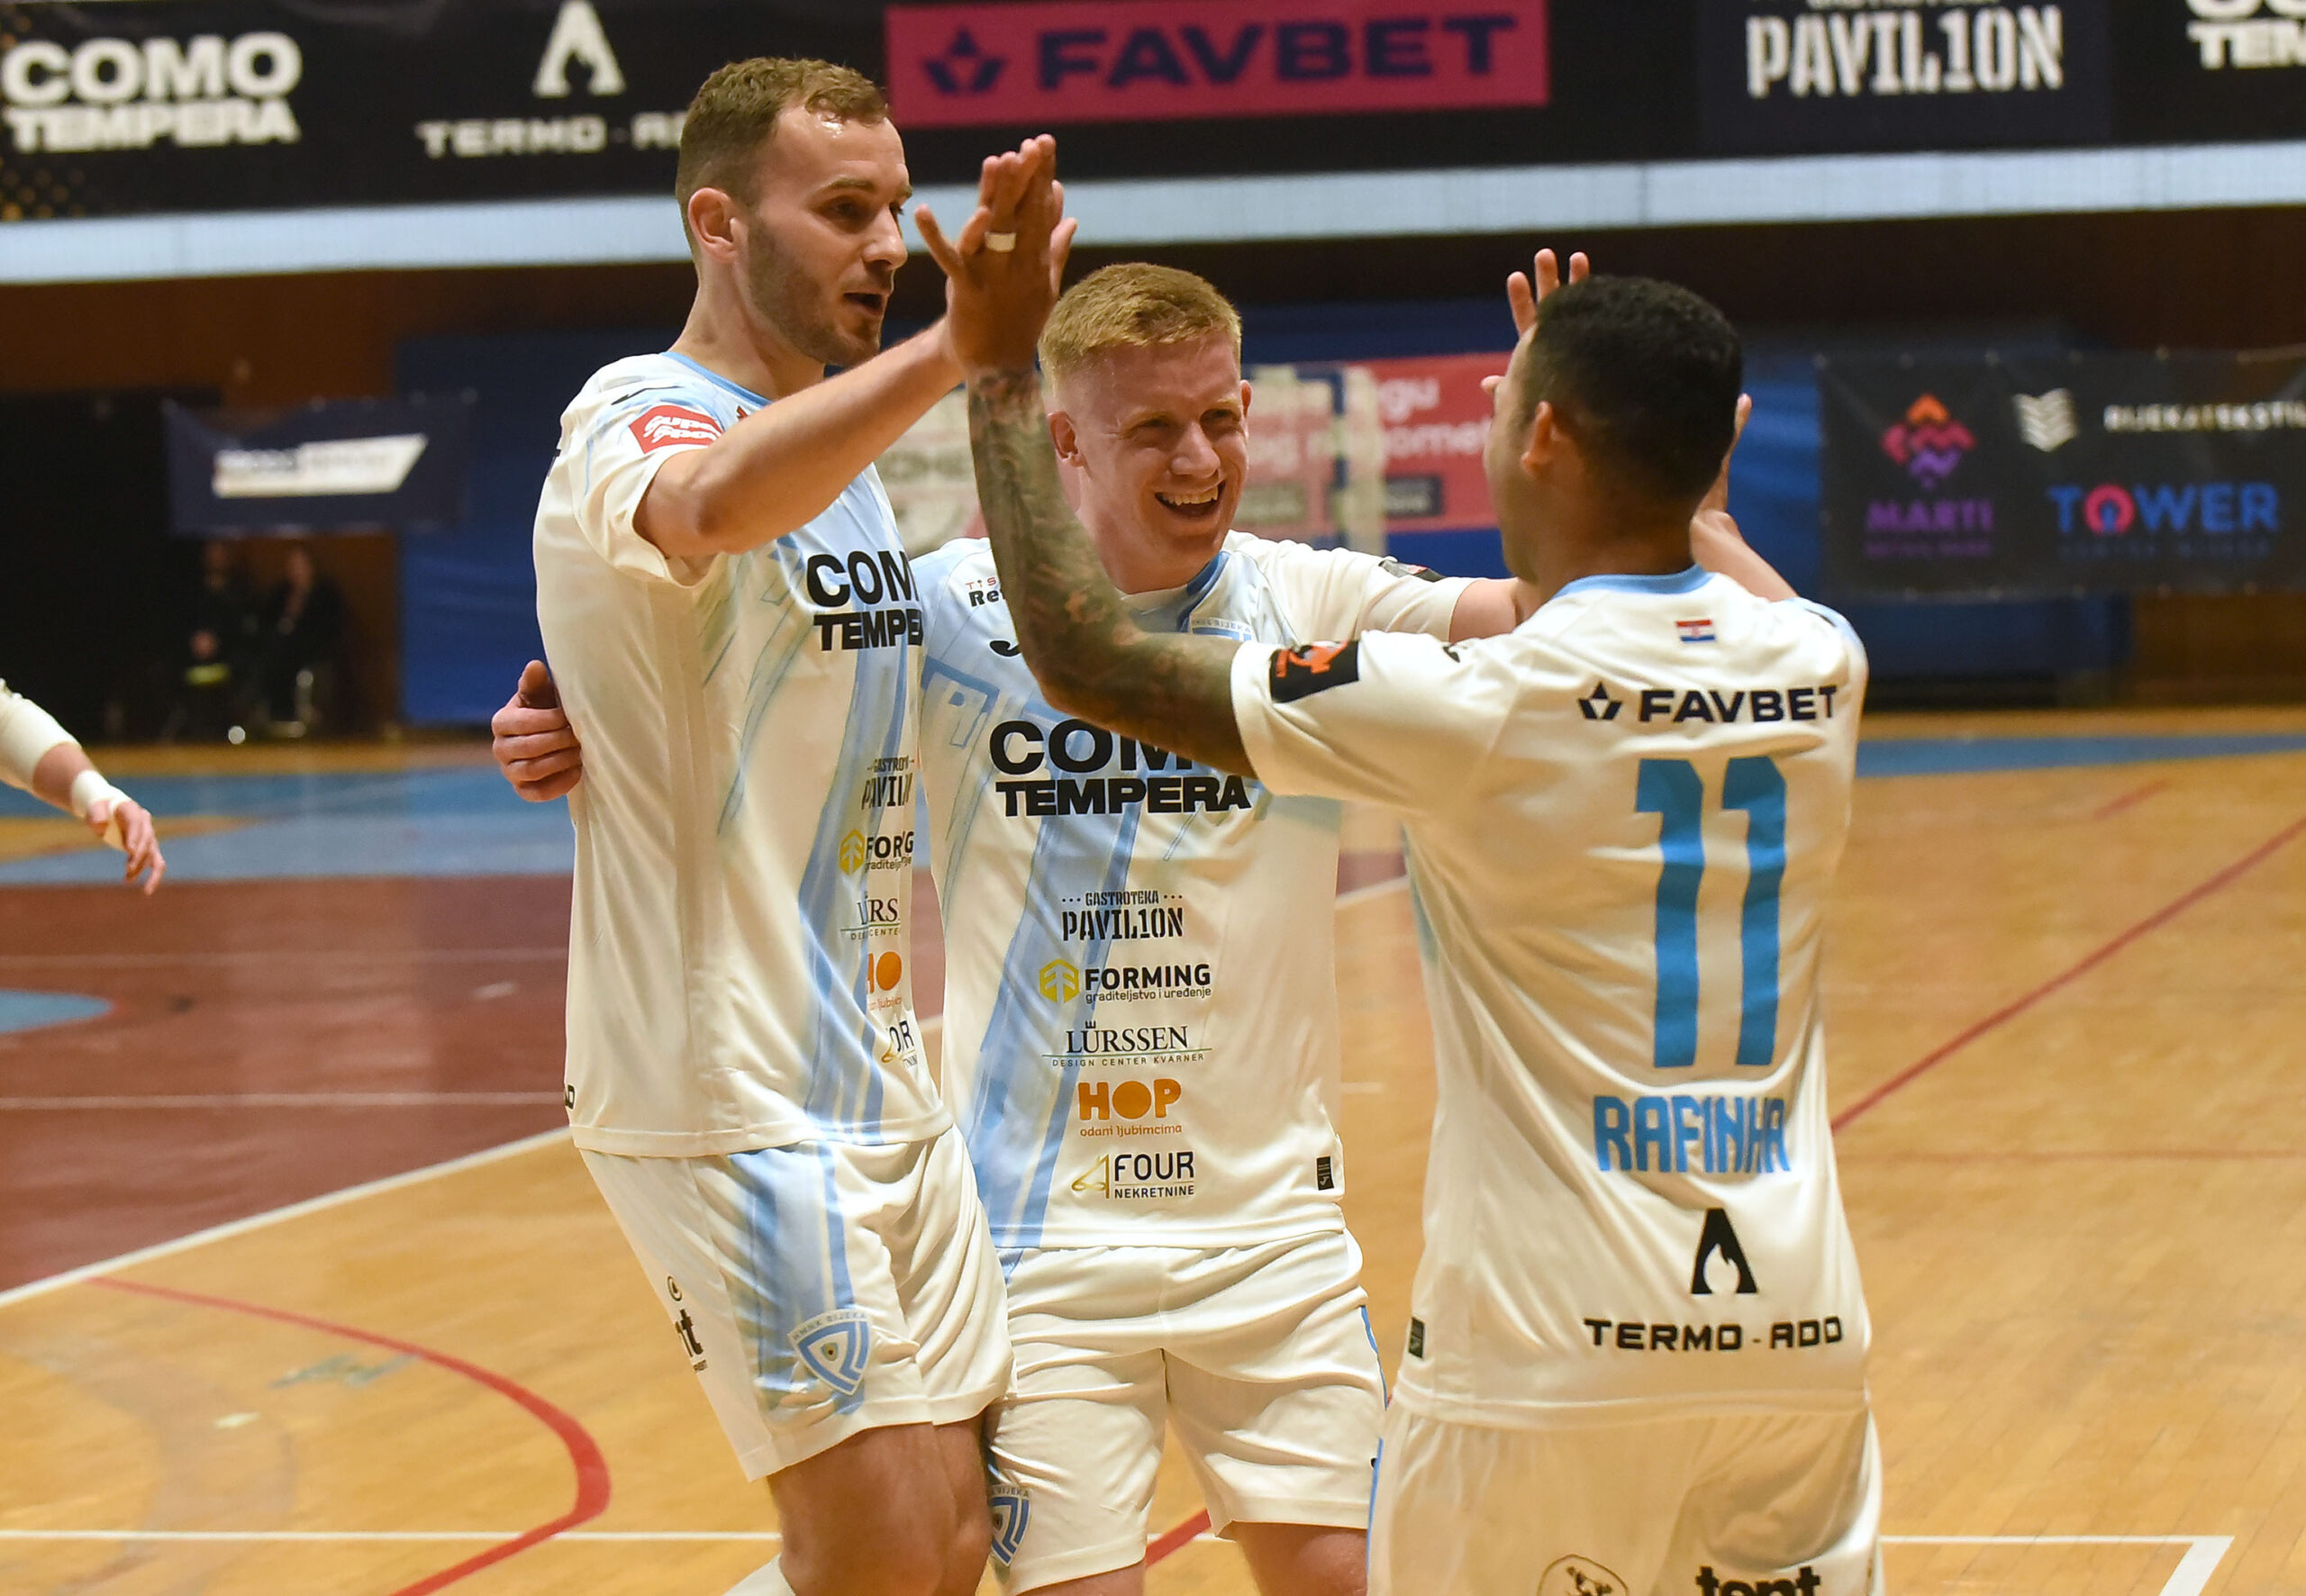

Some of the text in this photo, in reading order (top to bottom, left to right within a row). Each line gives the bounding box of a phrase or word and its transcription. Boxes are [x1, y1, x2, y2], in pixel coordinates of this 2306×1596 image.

[2, 31, 304, 109] COMO
[1034, 16, 1517, 89] FAVBET
[4, 98, 303, 154] TEMPERA
[414, 114, 605, 159] TERMO
[2047, 483, 2279, 533] TOWER
[1639, 685, 1837, 721] FAVBET
[995, 775, 1252, 817] TEMPERA
[1085, 890, 1159, 906] GASTROTEKA
[1635, 756, 1786, 1068] 11
[1085, 964, 1211, 990] FORMING
[1085, 992, 1156, 1004] graditeljstvo
[1164, 987, 1212, 1001] uređenje
[1052, 1054, 1204, 1067] DESIGN CENTER KVARNER
[1077, 1078, 1181, 1120] HOP
[1080, 1124, 1182, 1138] odani ljubimcima
[1593, 1095, 1791, 1174] RAFINHA
[1114, 1151, 1194, 1182] FOUR
[1114, 1185, 1194, 1199] NEKRETNINE
[1584, 1319, 1742, 1350] TERMO
